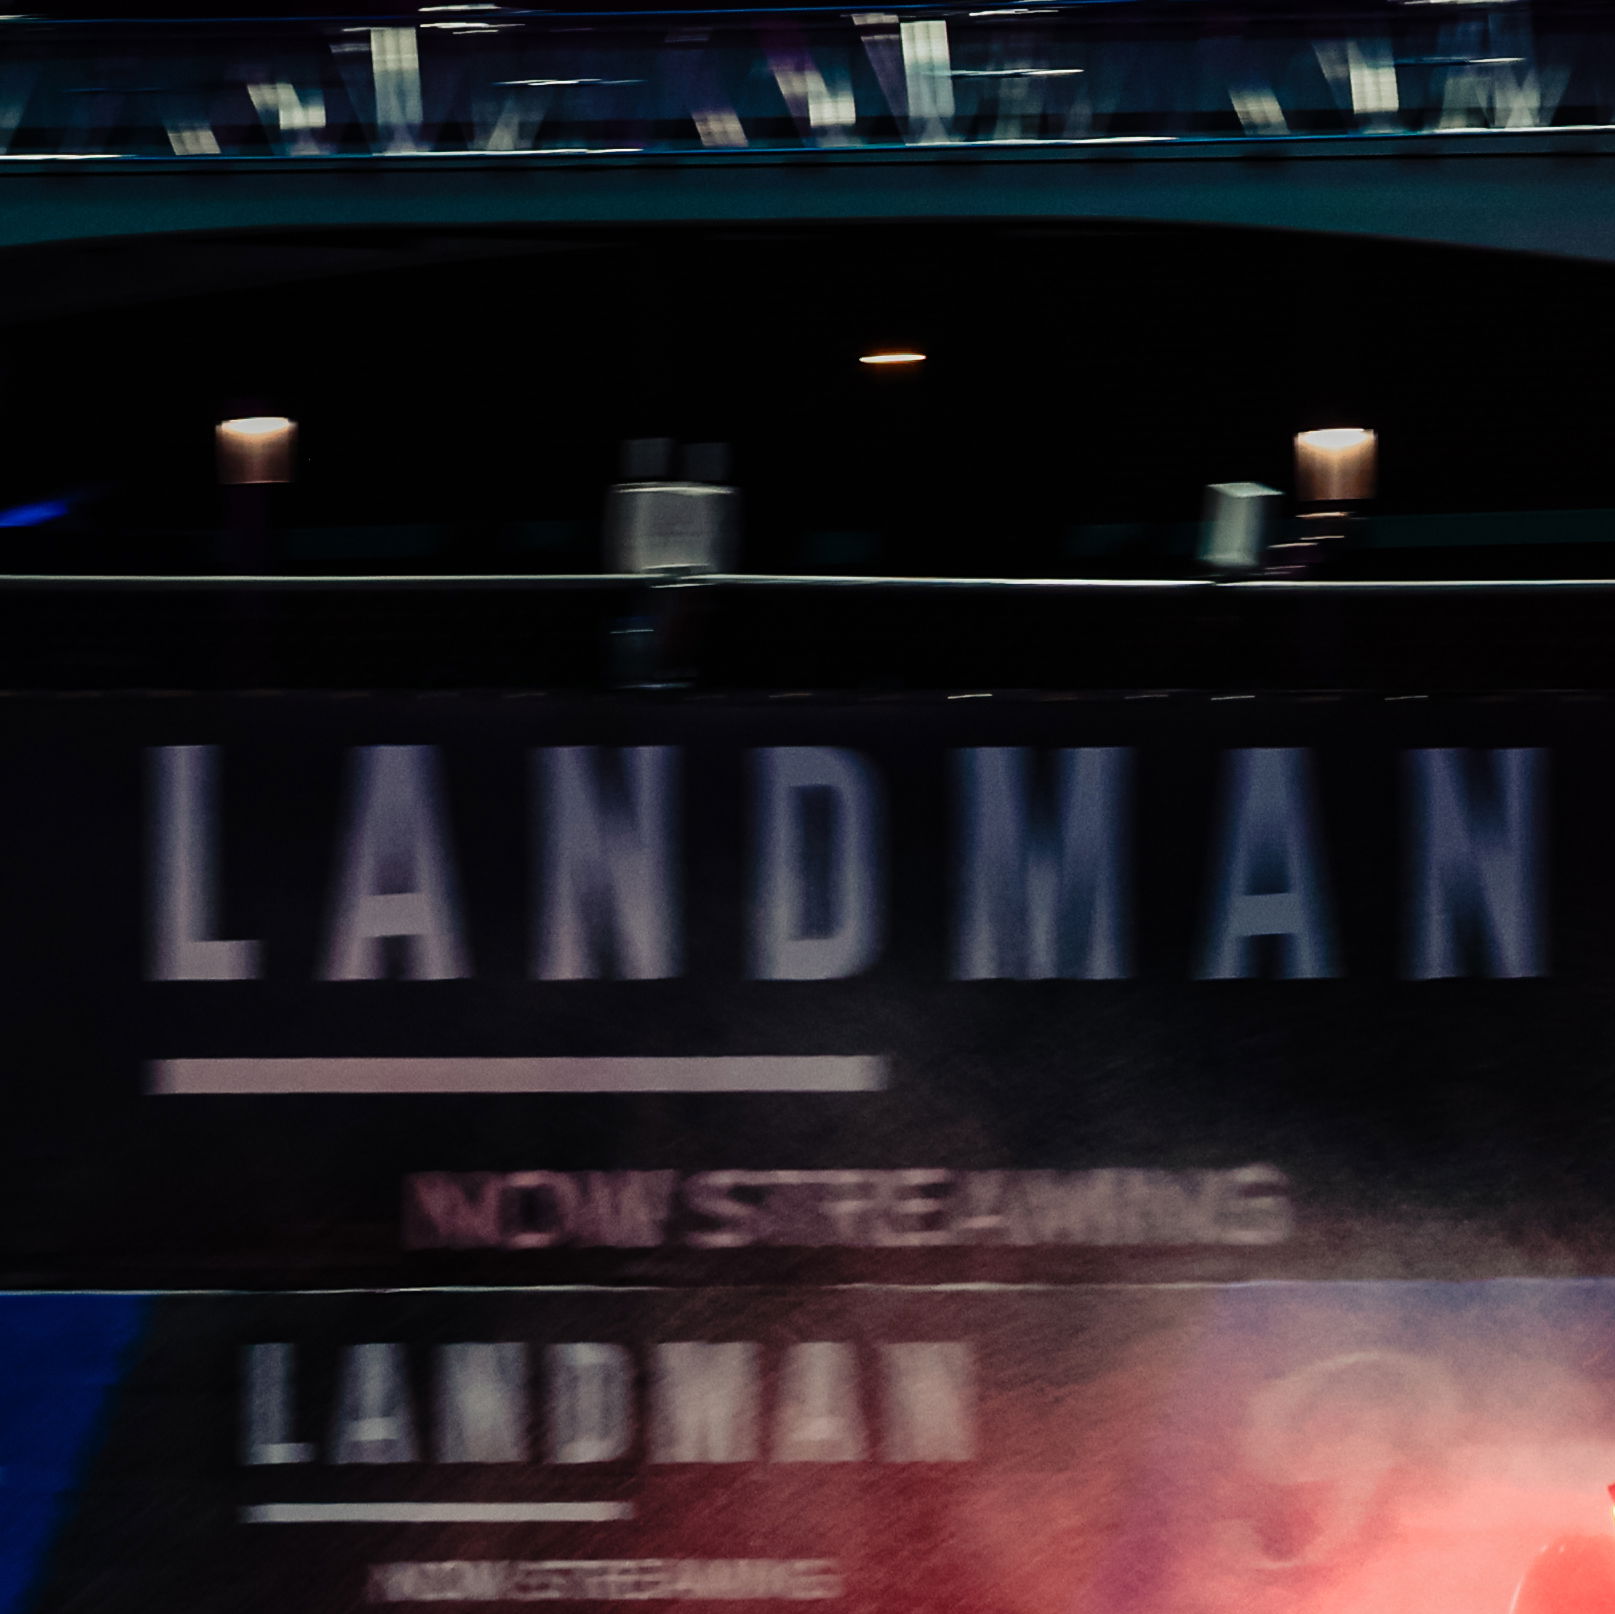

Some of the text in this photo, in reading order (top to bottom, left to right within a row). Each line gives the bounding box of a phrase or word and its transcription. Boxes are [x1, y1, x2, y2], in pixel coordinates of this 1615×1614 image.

[145, 745, 1553, 982] LANDMAN
[405, 1164, 1291, 1248] NOW STREAMING
[238, 1341, 979, 1465] LANDMAN
